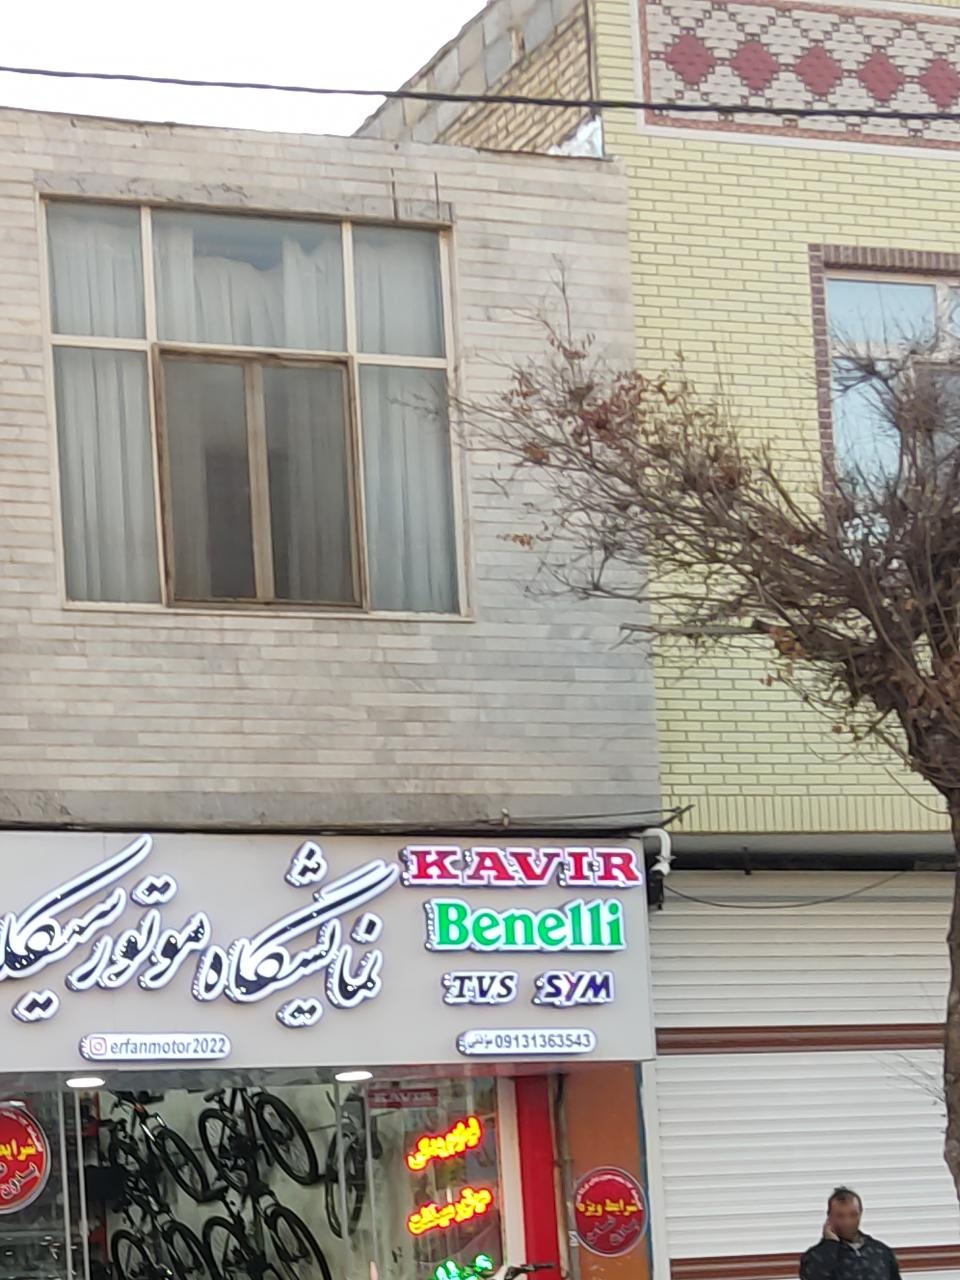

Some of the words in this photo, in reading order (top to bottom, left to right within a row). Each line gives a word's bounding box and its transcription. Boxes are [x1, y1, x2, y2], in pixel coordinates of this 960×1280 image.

[402, 846, 642, 887] KAVIR
[434, 900, 627, 951] Benelli
[451, 974, 515, 999] TVS
[544, 973, 611, 1001] SYM
[110, 1037, 227, 1055] erfanmotor2022
[494, 1033, 591, 1049] 09131363543
